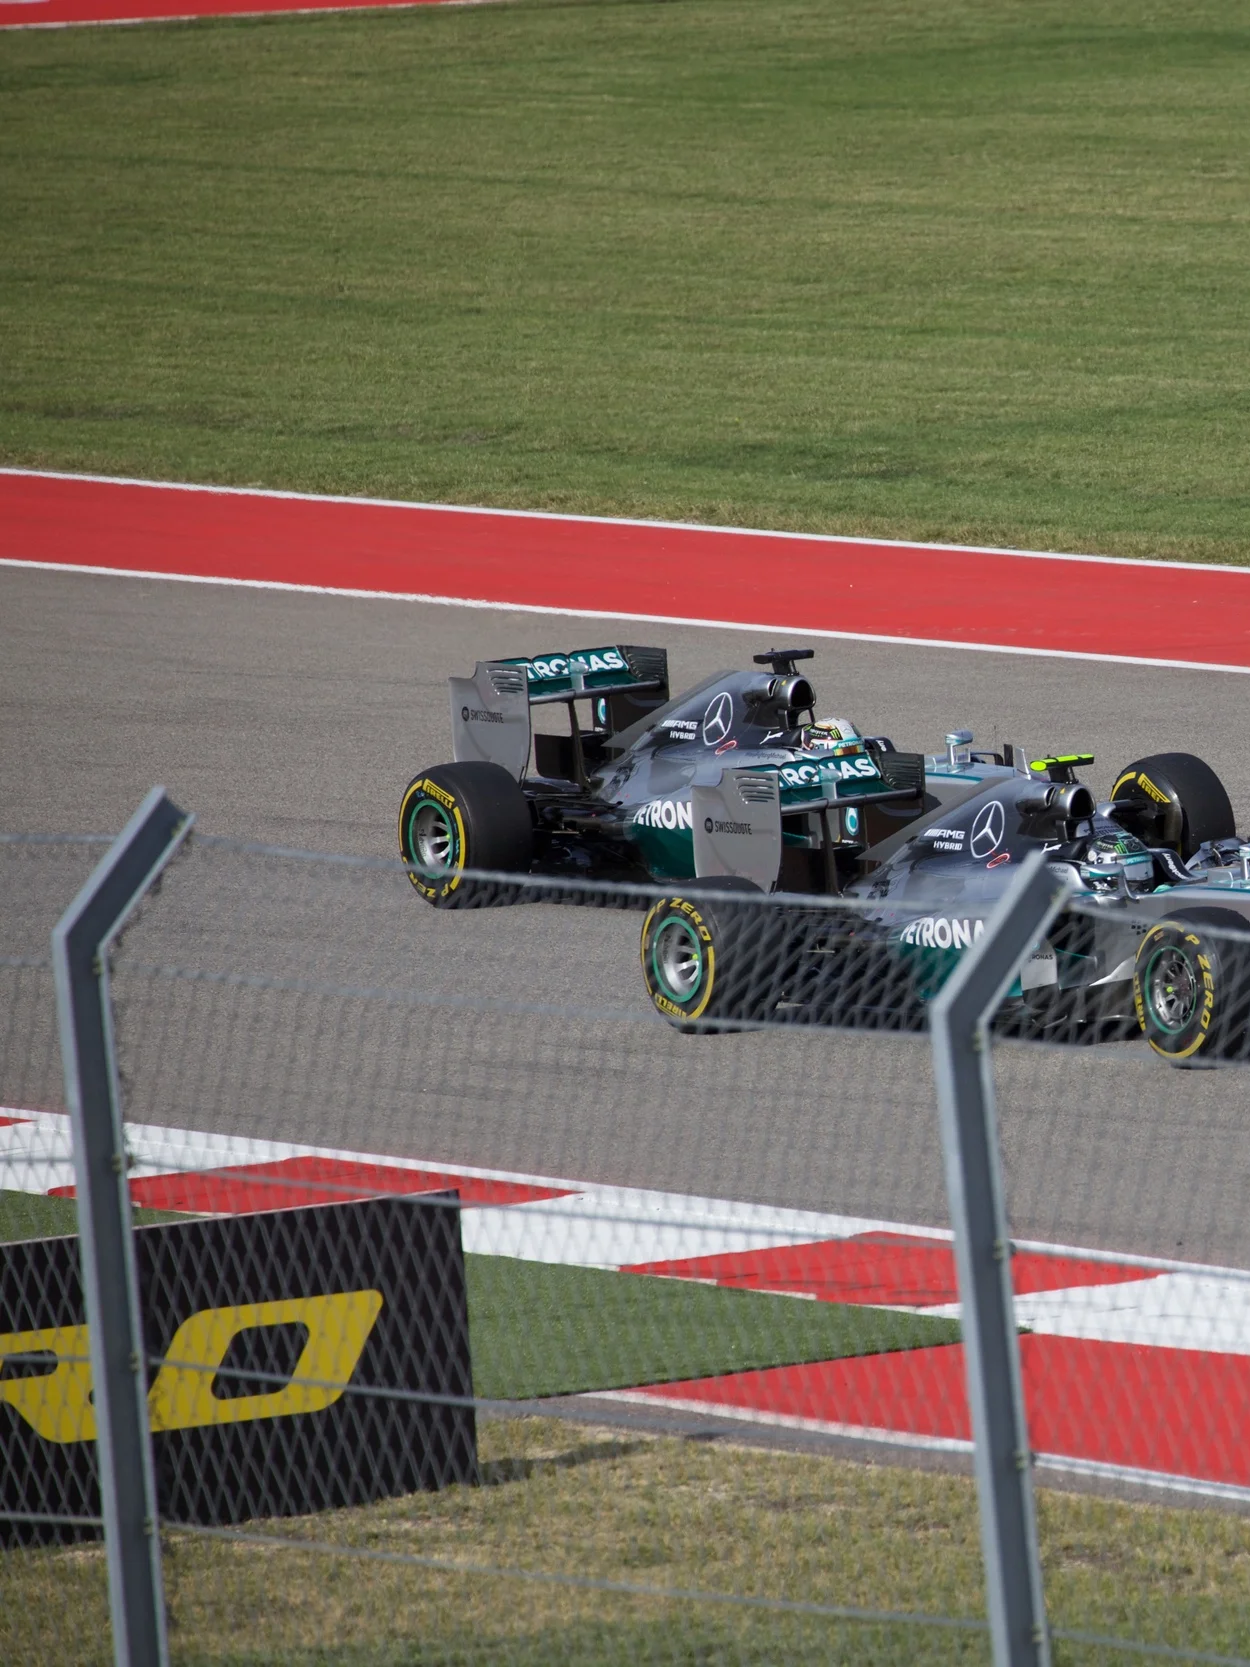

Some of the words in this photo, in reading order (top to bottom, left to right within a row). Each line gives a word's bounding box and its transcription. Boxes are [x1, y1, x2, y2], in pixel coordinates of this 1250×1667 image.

[673, 719, 698, 731] AMG
[669, 730, 696, 741] HYBRID
[422, 778, 455, 810] PIRELLI
[937, 828, 966, 840] AMG
[933, 839, 963, 851] HYBRID
[669, 897, 712, 942] ZERO
[1197, 953, 1215, 1031] ZERO
